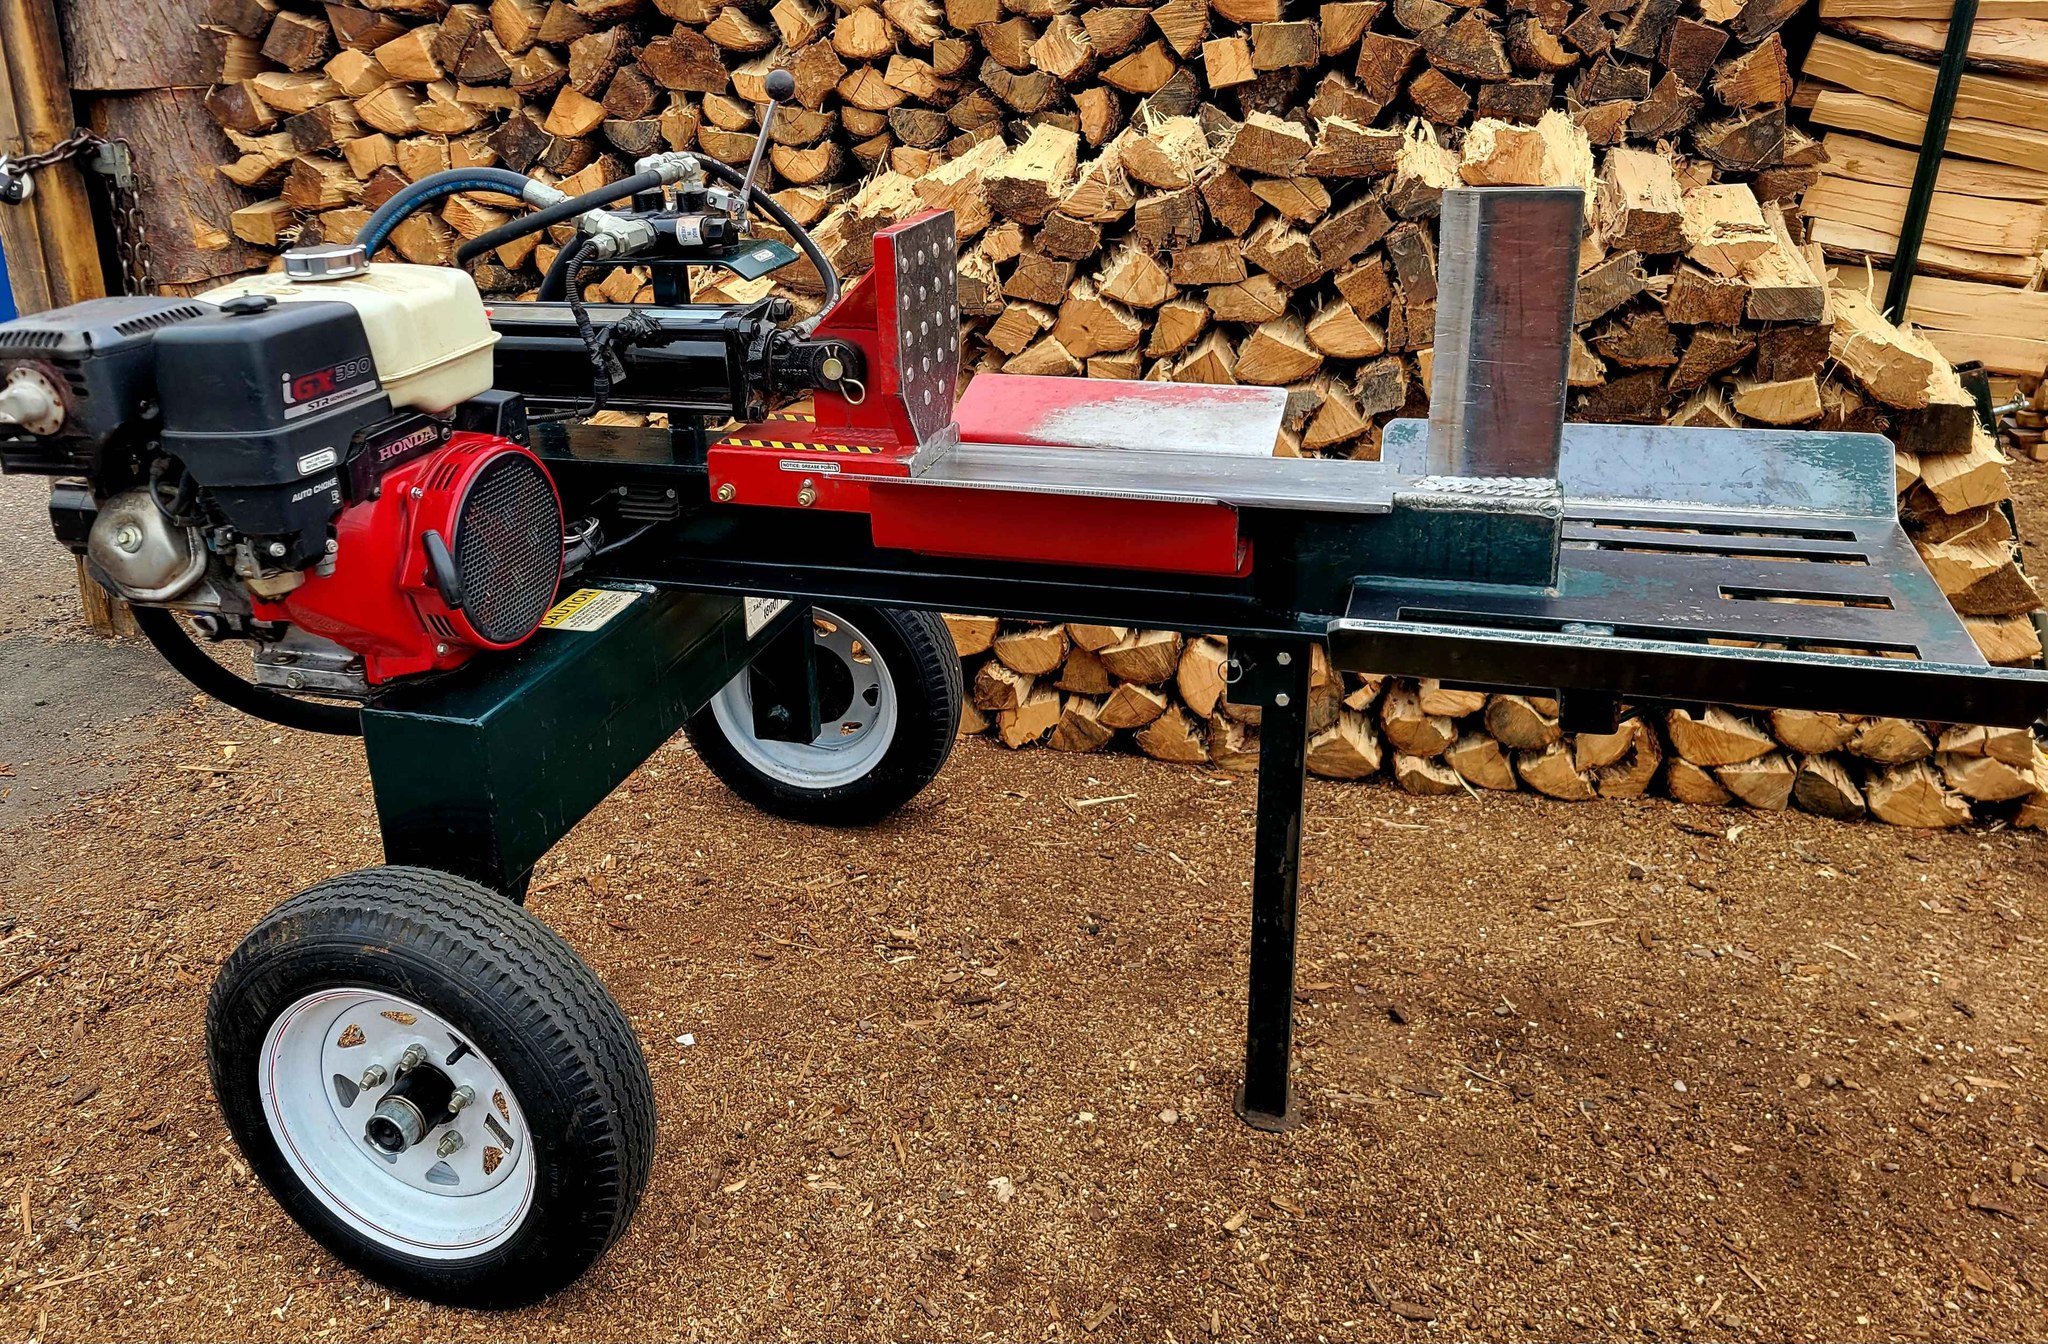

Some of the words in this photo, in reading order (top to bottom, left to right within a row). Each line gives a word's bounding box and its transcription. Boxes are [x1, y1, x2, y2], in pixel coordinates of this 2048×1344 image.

[307, 397, 330, 411] STR
[378, 426, 438, 462] HONDA
[291, 488, 313, 503] AUTO
[313, 477, 338, 494] CHOKE
[540, 590, 597, 626] CAUTION
